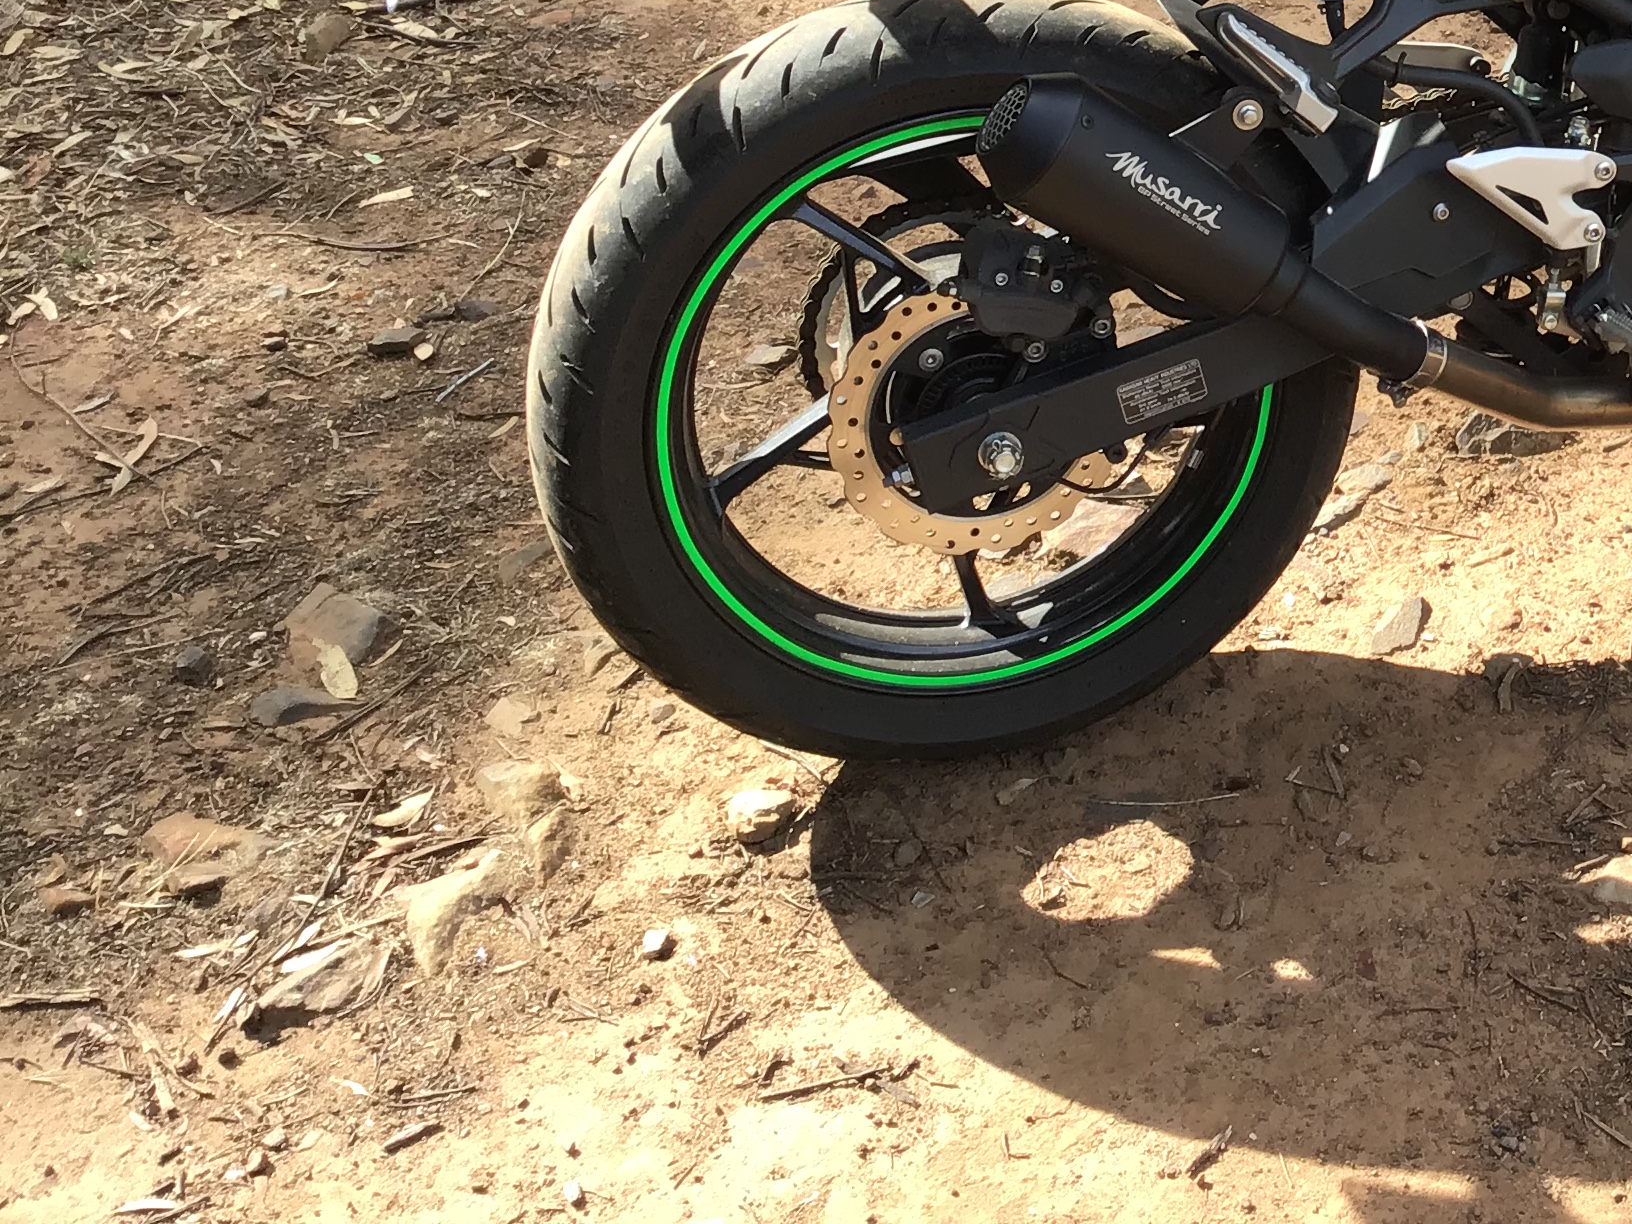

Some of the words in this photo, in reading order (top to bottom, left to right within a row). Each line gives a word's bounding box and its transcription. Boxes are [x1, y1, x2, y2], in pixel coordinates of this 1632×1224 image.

[1105, 151, 1222, 230] Musarri
[1150, 193, 1184, 218] Street
[1181, 213, 1211, 236] Series
